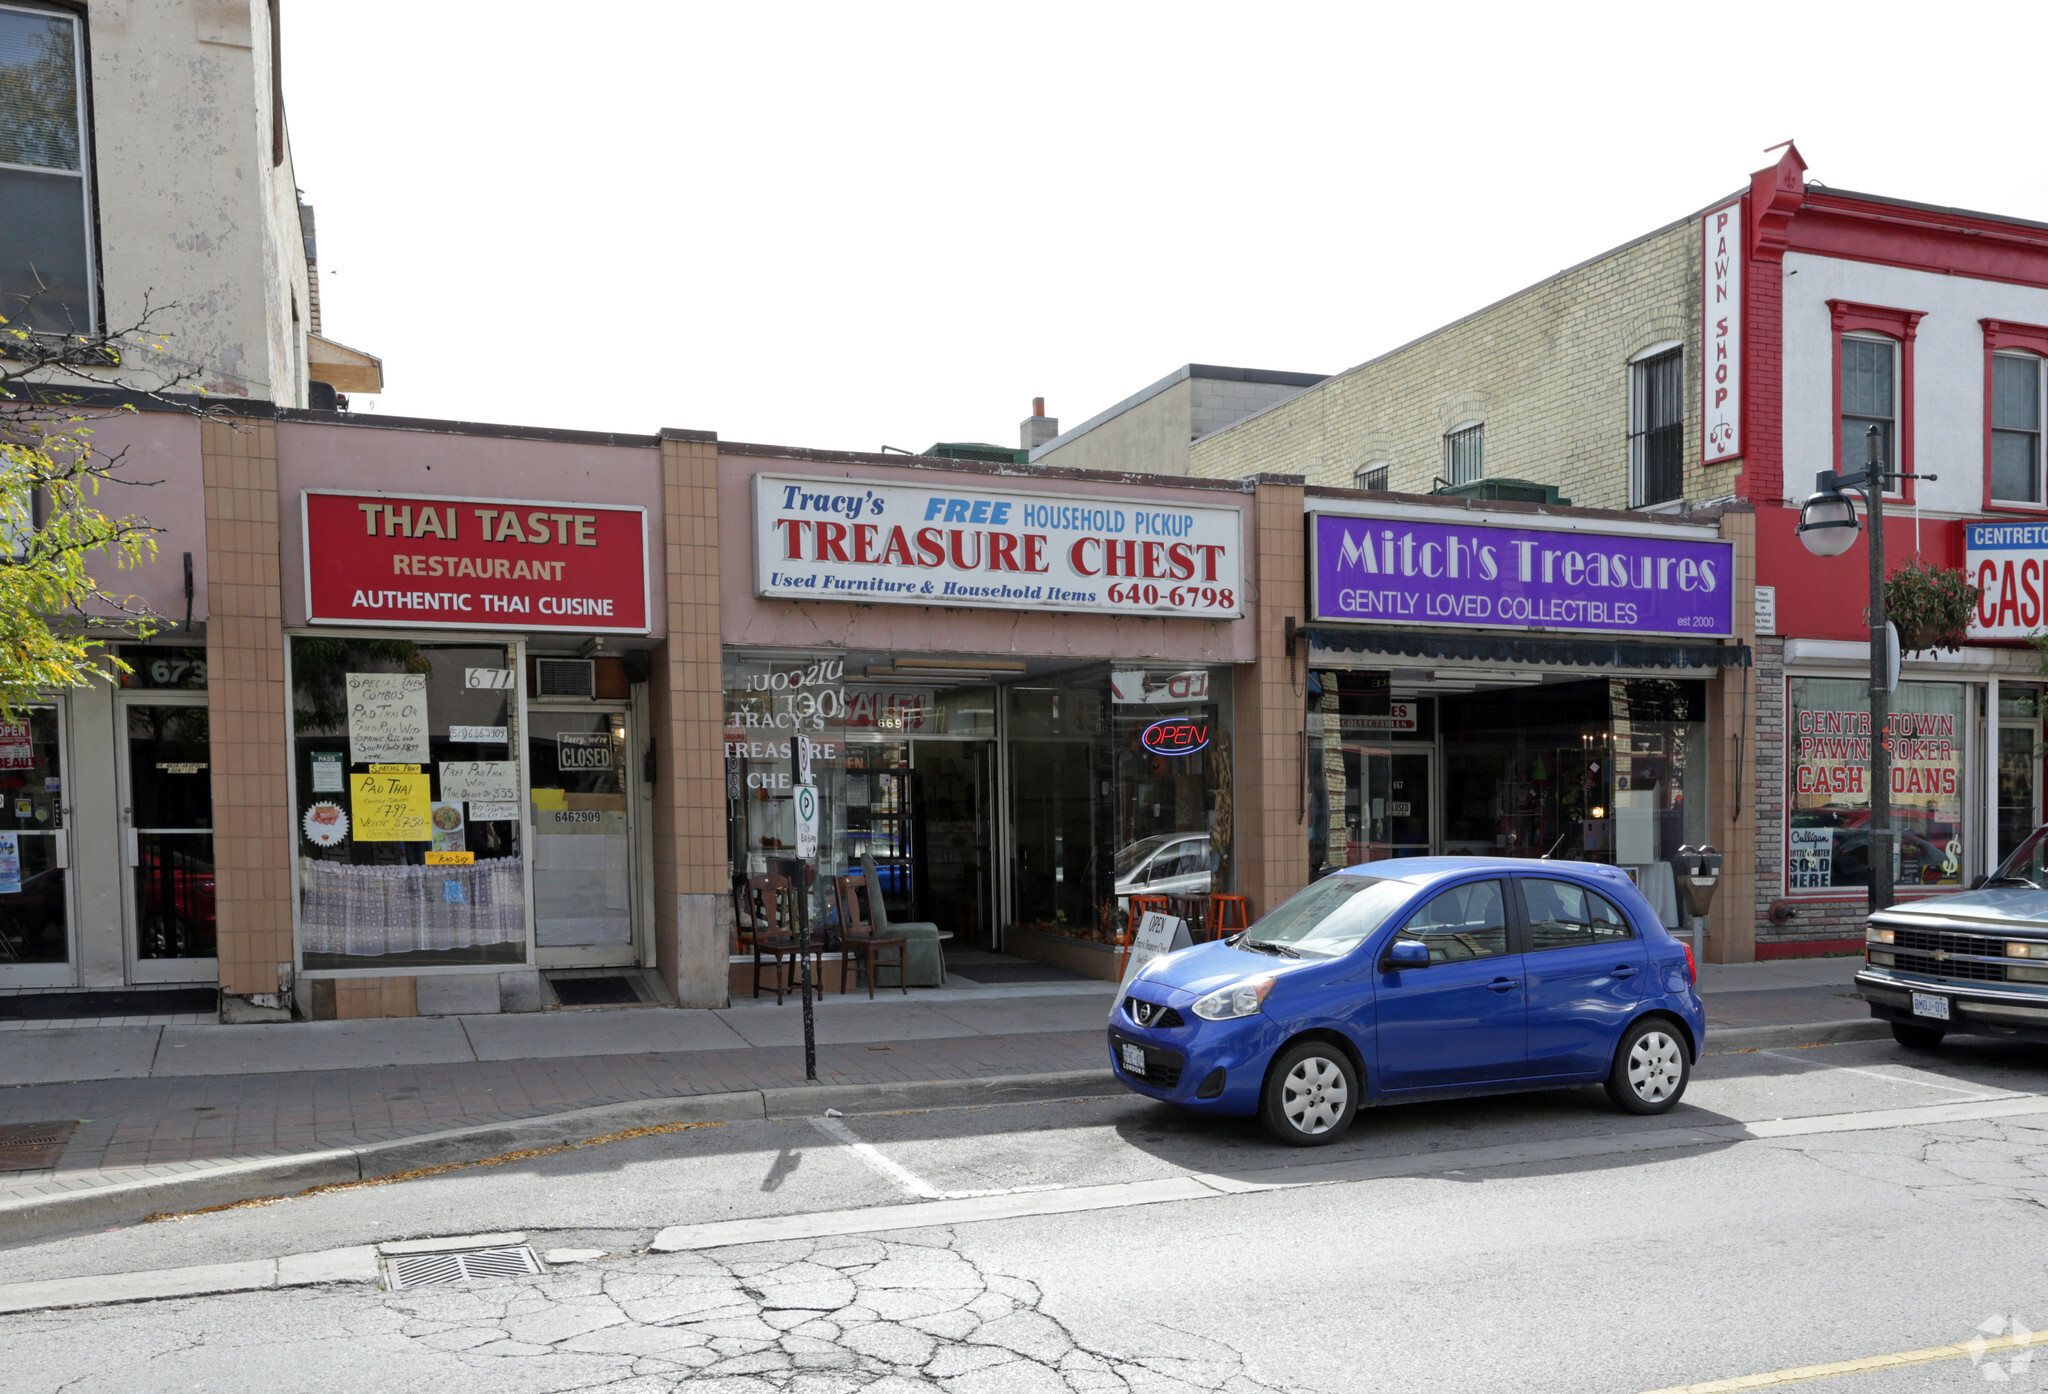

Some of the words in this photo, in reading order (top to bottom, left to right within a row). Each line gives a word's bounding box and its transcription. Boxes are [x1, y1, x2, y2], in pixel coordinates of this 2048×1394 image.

[1715, 212, 1730, 303] PAWN
[1715, 317, 1729, 409] SHOP
[782, 484, 886, 520] Tracy's
[923, 497, 1012, 526] FREE
[1023, 503, 1126, 535] HOUSEHOLD
[1135, 511, 1194, 537] PICKUP
[357, 503, 458, 539] THAI
[474, 509, 598, 547] TASTE
[1974, 526, 2048, 545] CENTRETO
[772, 518, 1050, 574] TREASURE
[1067, 535, 1227, 583] CHEST
[1337, 527, 1499, 581] Mitch's
[1510, 540, 1717, 593] Treasures
[393, 554, 566, 581] RESTAURANT
[770, 571, 817, 589] Used
[822, 574, 916, 594] Furniture
[920, 580, 935, 595] &
[942, 581, 1043, 601] Household
[1047, 585, 1097, 603] Items
[1107, 582, 1236, 609] 640-6798
[1977, 558, 2048, 629] CAS
[352, 589, 472, 612] AUTHENTIC
[480, 594, 530, 613] THAI
[538, 597, 614, 616] CUISINE
[1338, 588, 1420, 614] GENTLY
[1426, 593, 1492, 617] LOVED
[1497, 597, 1638, 625] COLLECTIBLES
[1677, 617, 1691, 628] est
[1692, 616, 1715, 629] 2000
[151, 660, 207, 684] 673
[468, 668, 511, 689] 671
[405, 679, 424, 688] NEW
[362, 689, 405, 701] COMBOS
[351, 704, 376, 719] PAD
[401, 705, 418, 718] OR
[731, 711, 825, 729] TRACYS
[0, 726, 26, 737] OPEN
[877, 718, 902, 728] 669
[1799, 711, 1955, 736] CENTRTOWN
[1144, 726, 1207, 744] OPEN
[561, 747, 610, 768] CLOSED
[724, 742, 836, 759] TREASRE
[1800, 736, 1952, 761] PAWNROKER
[442, 763, 464, 777] FREE
[360, 776, 384, 795] PAD
[387, 778, 413, 795] THAI
[747, 773, 817, 788] CHE
[1393, 781, 1404, 789] 667
[1797, 765, 1865, 795] CASH
[1889, 766, 1956, 795] OANS
[555, 811, 601, 823] 6462909
[1388, 803, 1409, 812] CLOSED
[1791, 830, 1830, 849] Culligan
[1790, 873, 1829, 888] HERE
[1148, 915, 1167, 933] OPEN
